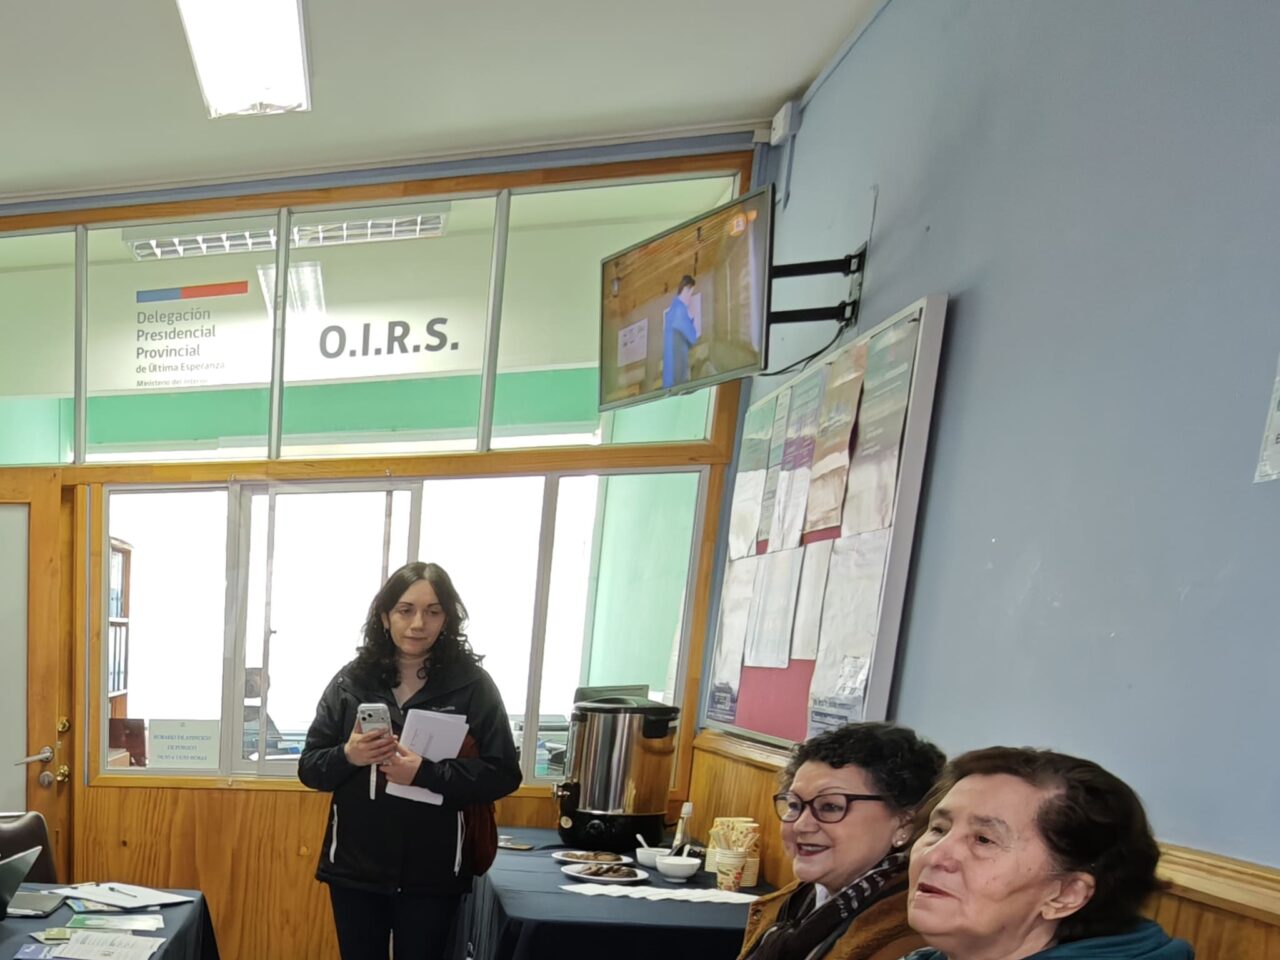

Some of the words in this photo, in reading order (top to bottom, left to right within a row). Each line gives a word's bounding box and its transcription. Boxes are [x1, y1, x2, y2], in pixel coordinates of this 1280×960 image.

[136, 307, 211, 326] Delegación
[136, 325, 216, 342] Presidencial
[319, 317, 459, 359] O.I.R.S.
[136, 344, 201, 360] Provincial
[136, 364, 147, 374] de
